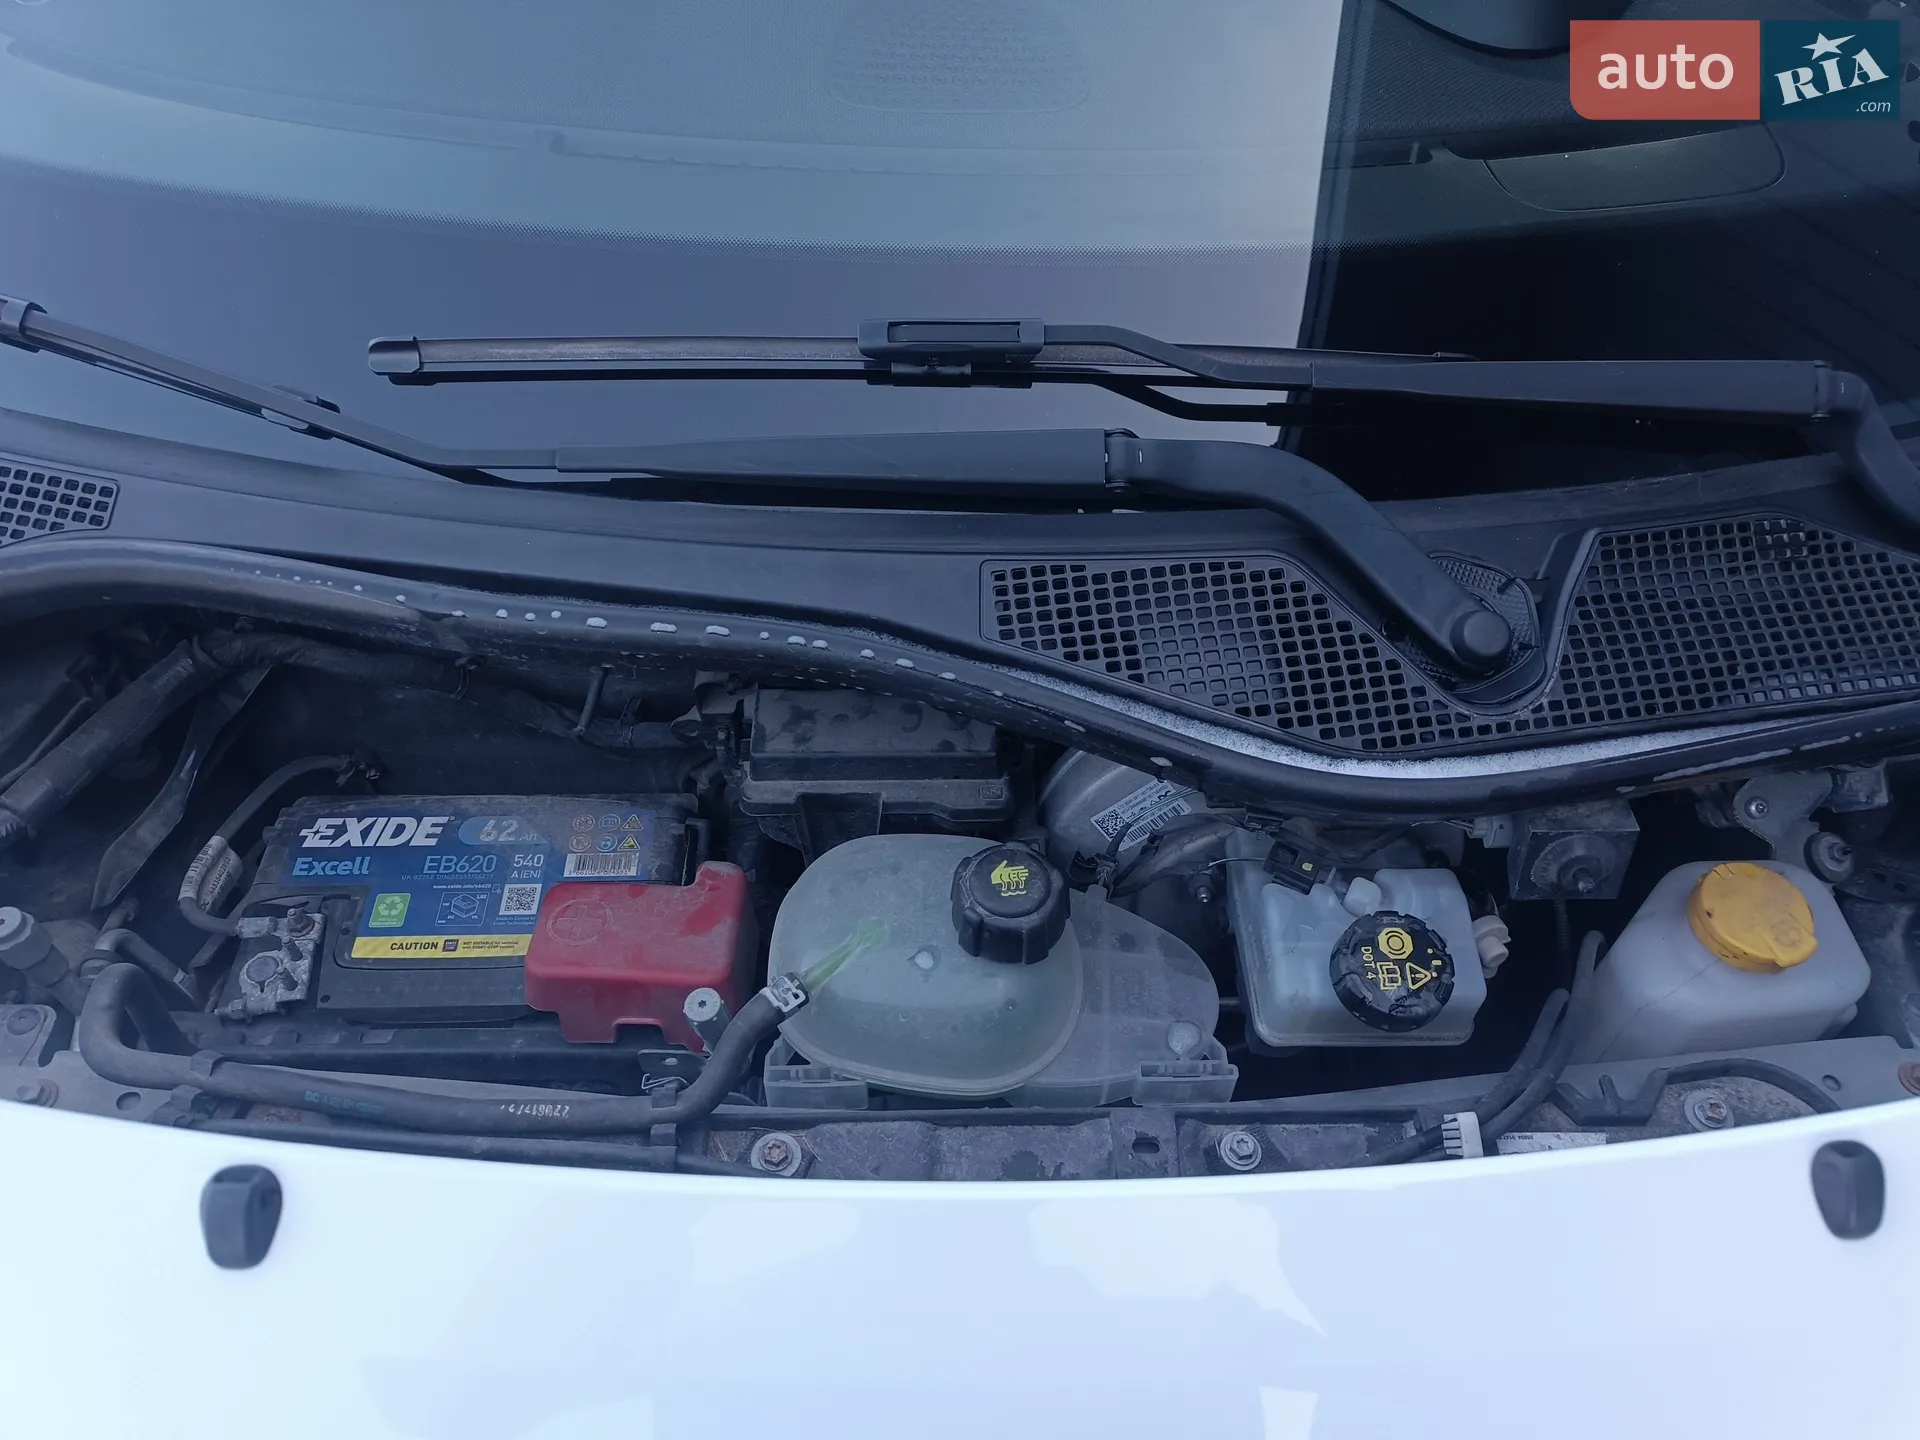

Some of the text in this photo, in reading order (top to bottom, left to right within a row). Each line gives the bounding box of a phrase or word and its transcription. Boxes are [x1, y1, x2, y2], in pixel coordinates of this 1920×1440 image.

[299, 816, 449, 848] EXIDE
[480, 819, 519, 841] 62
[292, 856, 371, 876] Excell
[423, 855, 497, 874] EB620
[513, 854, 544, 867] 540
[511, 869, 541, 879] A (EN)
[390, 942, 439, 950] CAUTION
[1361, 946, 1377, 980] DOT 4
